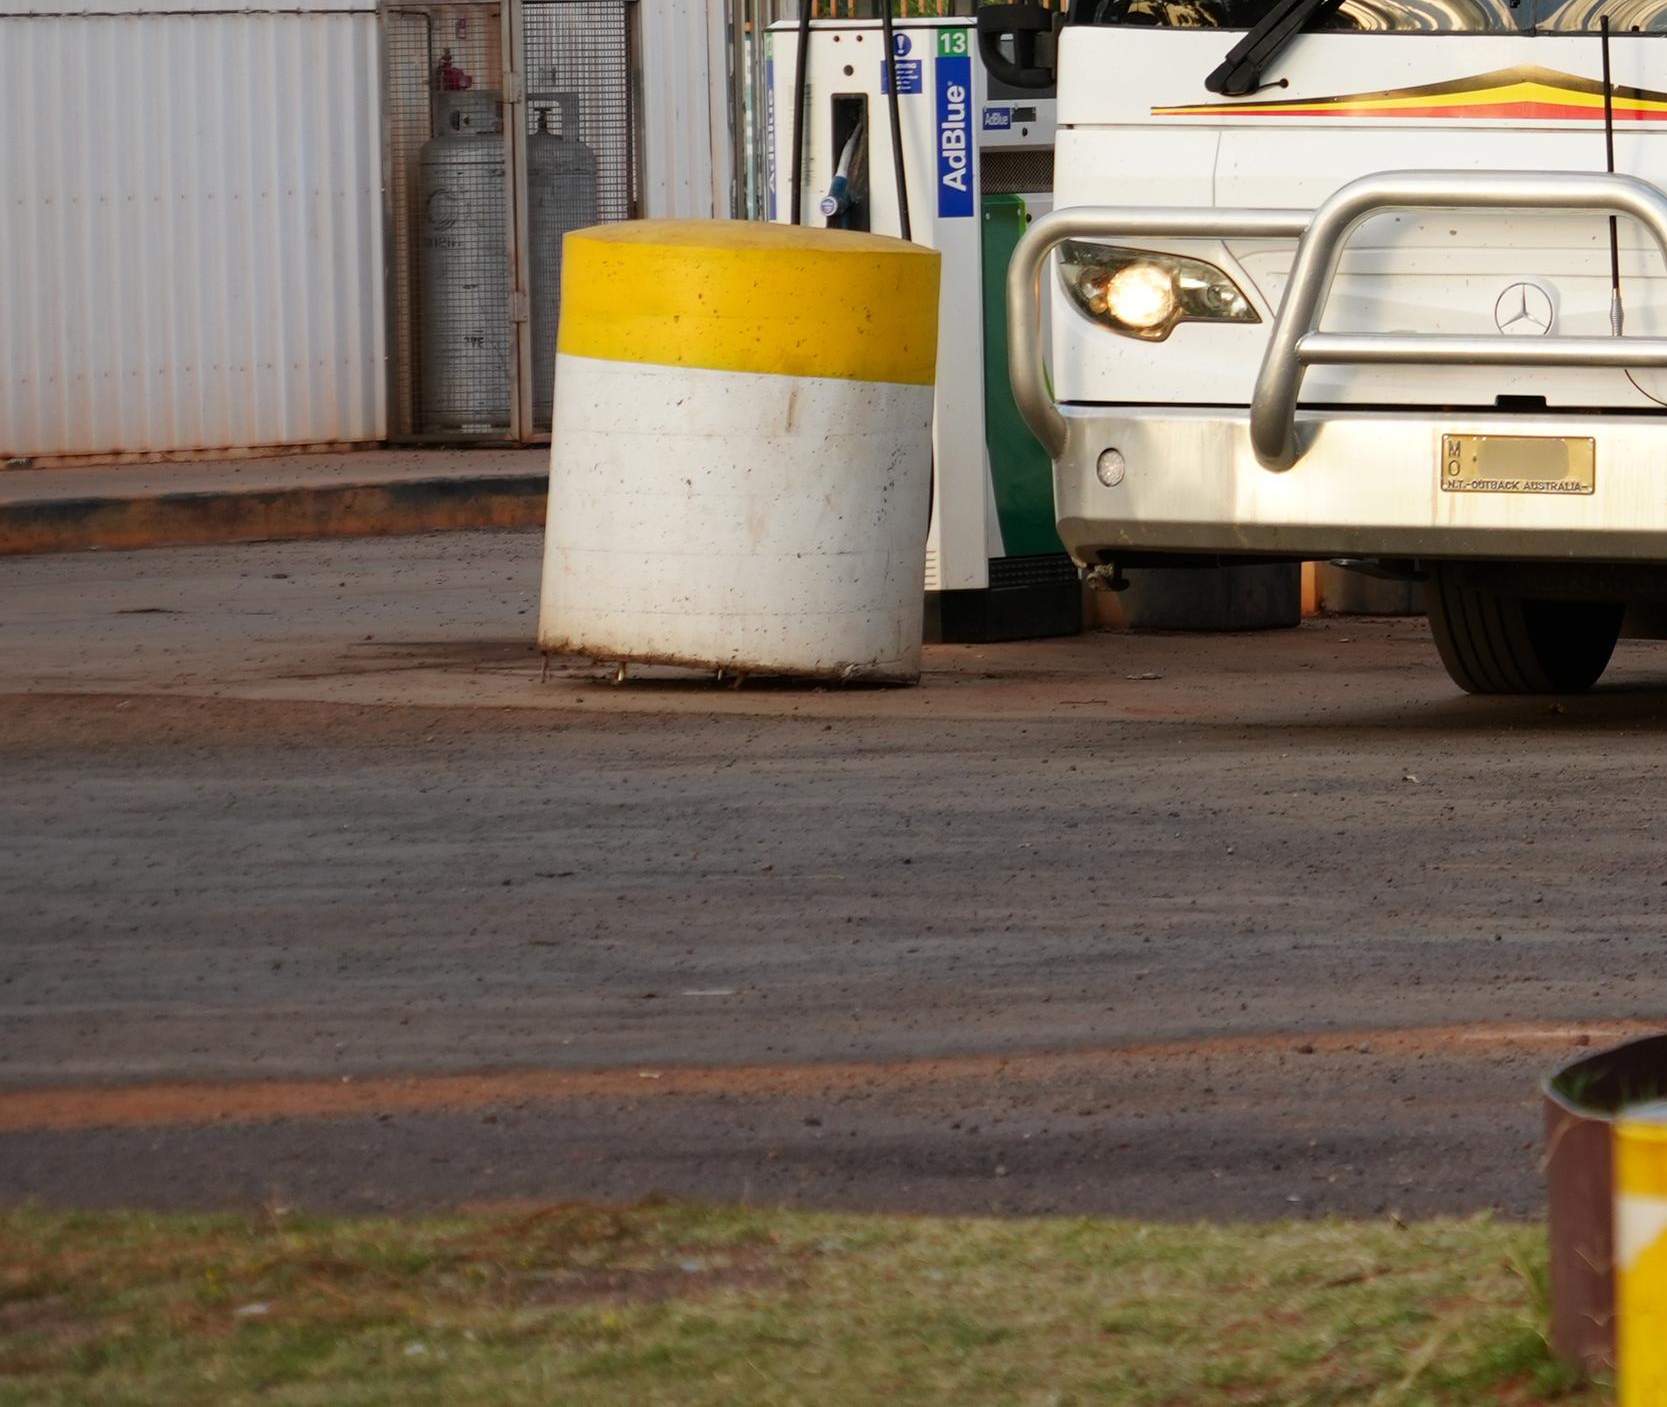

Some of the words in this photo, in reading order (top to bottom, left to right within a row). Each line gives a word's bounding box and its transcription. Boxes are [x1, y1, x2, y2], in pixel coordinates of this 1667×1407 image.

[940, 32, 966, 53] 13
[985, 113, 1008, 126] AdBlue
[942, 84, 966, 192] AdBlue
